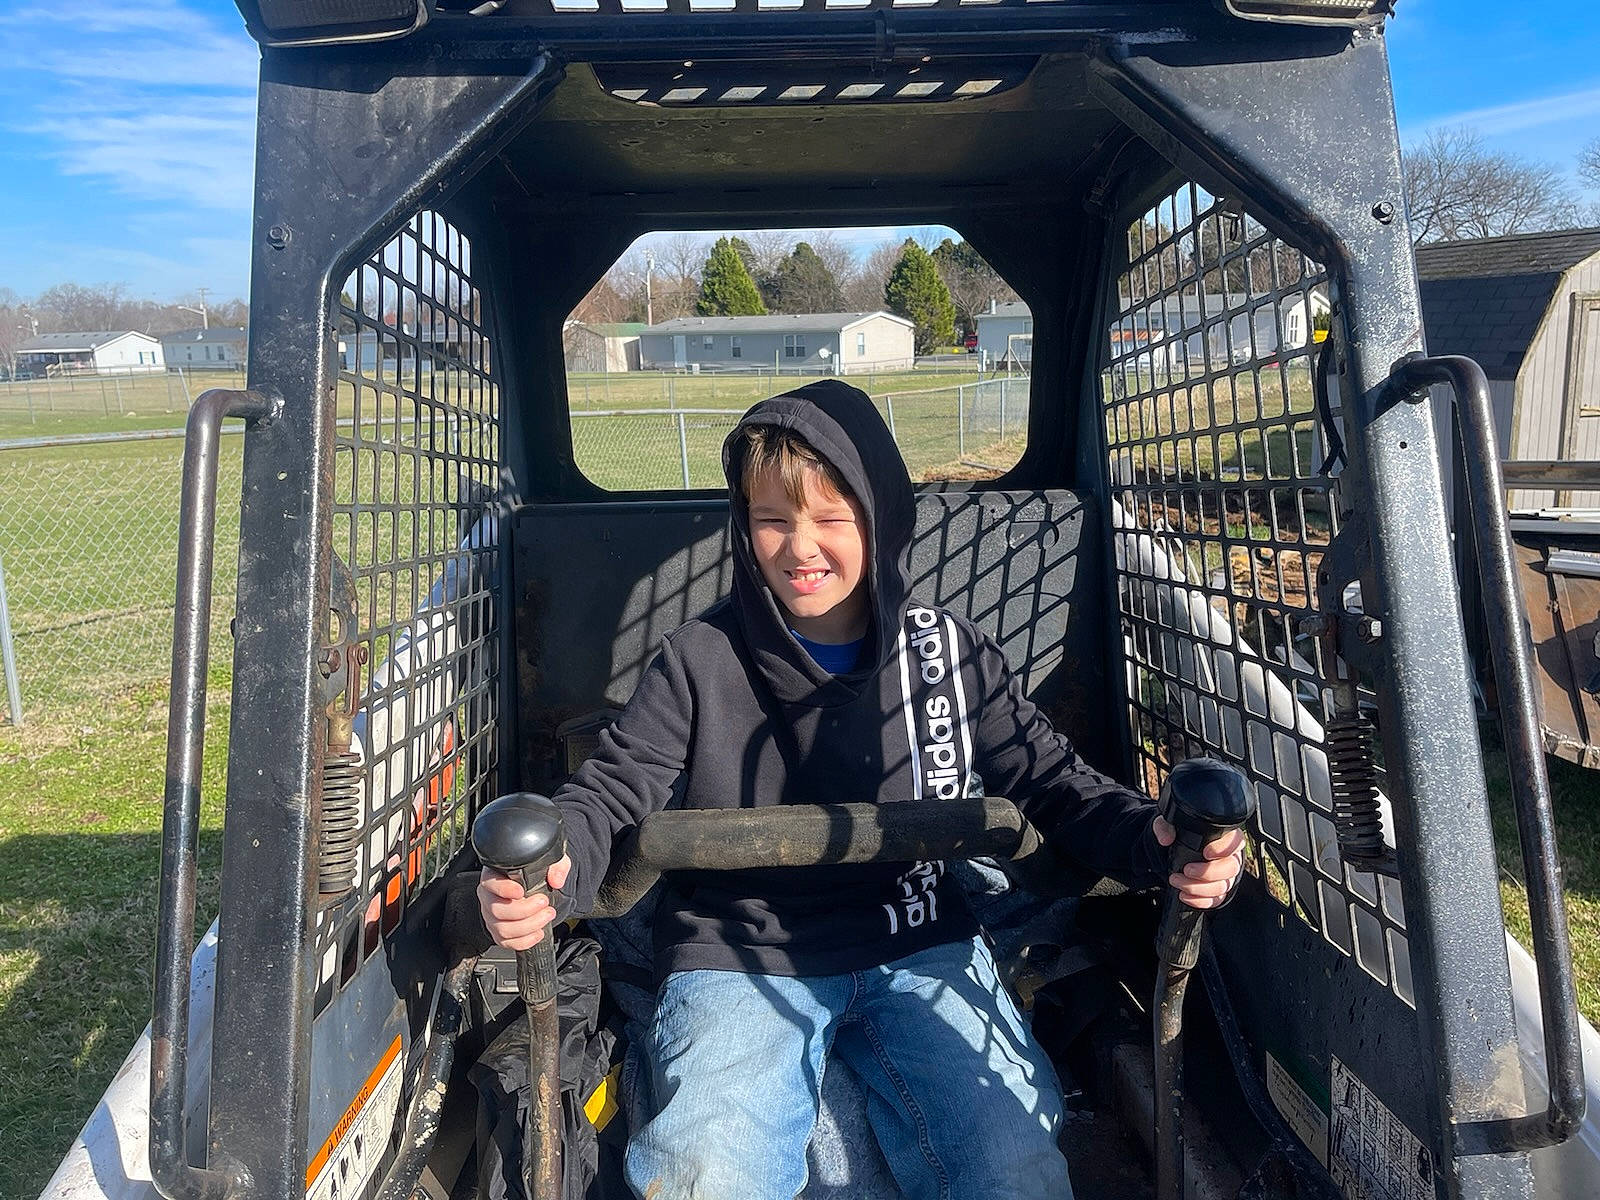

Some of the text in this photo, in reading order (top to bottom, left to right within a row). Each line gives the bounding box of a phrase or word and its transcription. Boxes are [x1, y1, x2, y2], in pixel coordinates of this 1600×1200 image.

[907, 606, 959, 800] didas adid
[334, 1085, 369, 1143] WARNING
